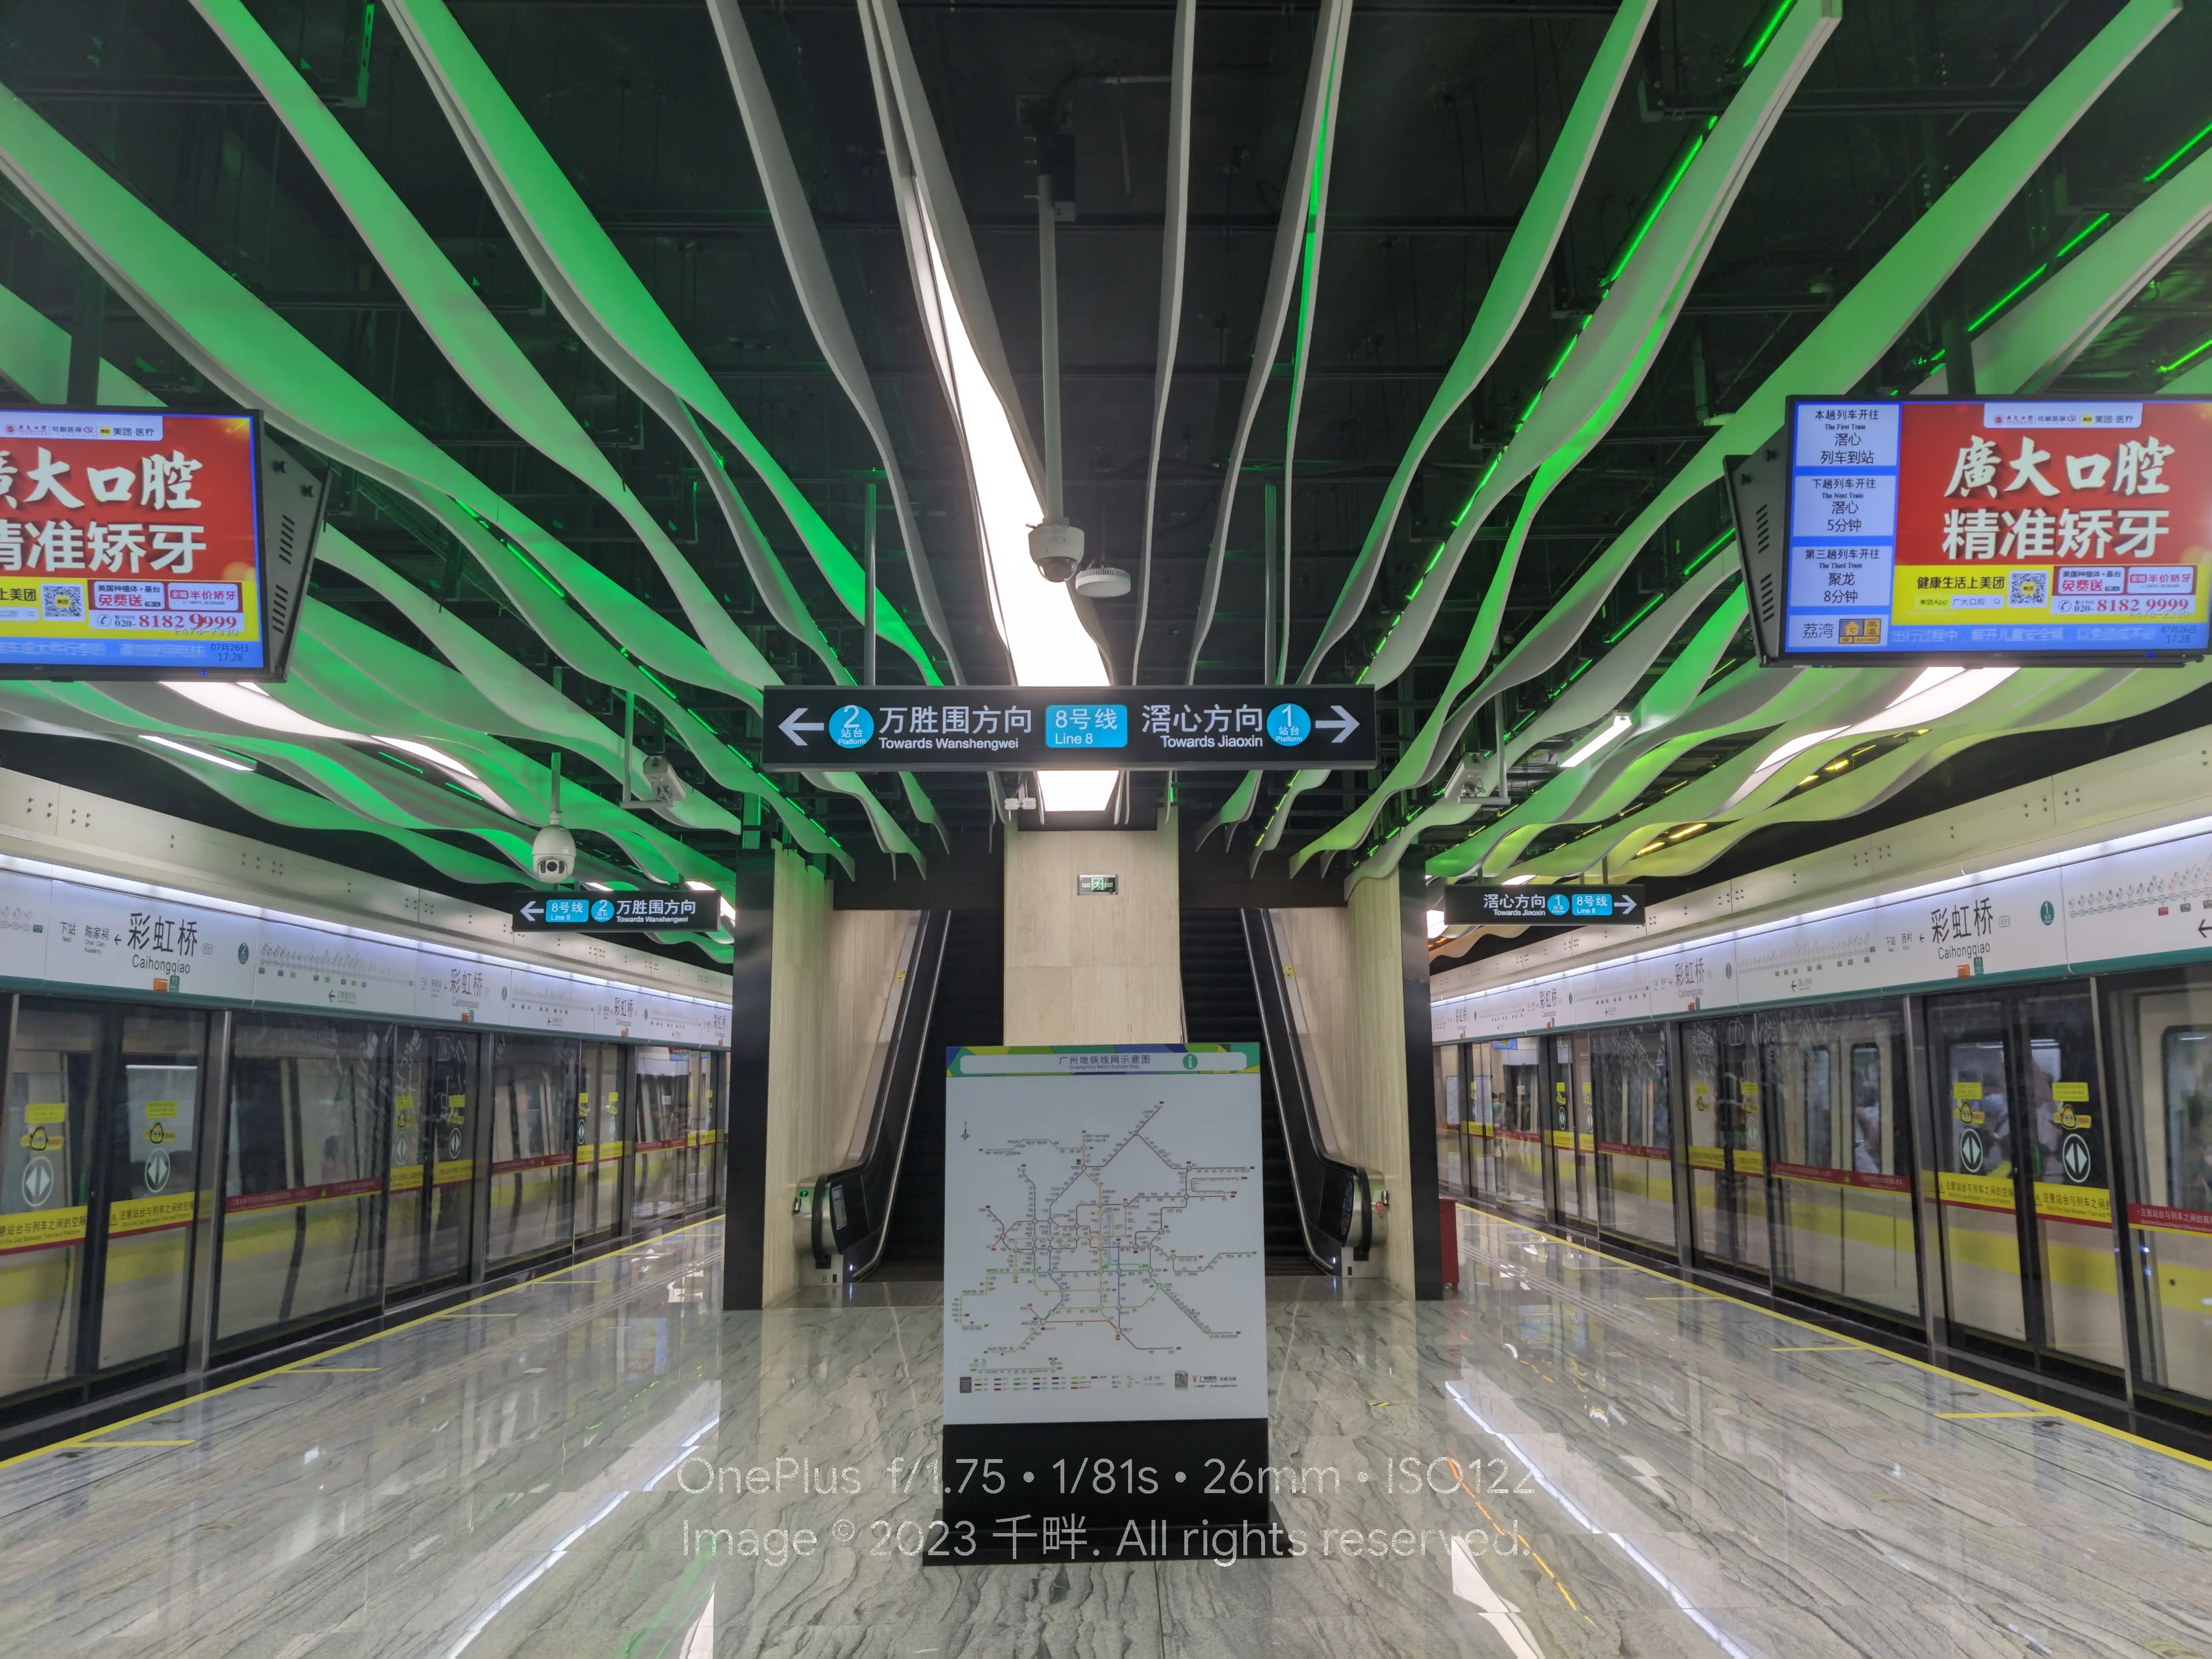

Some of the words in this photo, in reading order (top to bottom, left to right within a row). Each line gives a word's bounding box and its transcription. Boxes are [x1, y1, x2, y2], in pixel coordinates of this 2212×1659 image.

[1815, 409, 1879, 420] 本趟列车开往
[1835, 432, 1861, 447] 滘心
[1821, 450, 1875, 465] 列车到站
[1812, 478, 1876, 489] 下趟列车开往
[1832, 501, 1859, 515] 滘心
[1827, 518, 1861, 532] 5分钟
[1942, 508, 2170, 562] 精准矫牙
[1805, 549, 1880, 560] 第三趟列车开往
[1828, 572, 1855, 586] 聚龙
[1917, 576, 2005, 590] 健康生活上美团
[2062, 579, 2103, 592] 免费送
[99, 594, 143, 607] 免费送
[190, 590, 237, 600] 半价矫牙
[1824, 590, 1858, 604] 8分钟
[2097, 599, 2140, 612] 8182
[2146, 599, 2189, 611] 9999
[139, 615, 185, 629] 8182
[189, 613, 237, 629] 9999
[1803, 623, 1835, 639] 荔湾
[2161, 626, 2197, 634] 07月26日
[2166, 635, 2190, 643] 17:28
[211, 644, 248, 652] 07月26日
[218, 653, 243, 661] 17:28
[843, 704, 860, 729] 2
[878, 705, 1032, 734] 万胜围方向
[1055, 707, 1118, 730] 8号线
[1141, 704, 1263, 734] 滘心方向
[1282, 704, 1292, 727] 1
[841, 728, 863, 738] 站台
[1278, 726, 1300, 736] 站台
[838, 738, 867, 746] Platform
[878, 737, 933, 749] Towards
[936, 737, 1019, 751] Wanshengwei
[1055, 733, 1082, 744] Line
[1085, 733, 1093, 744] 8
[1160, 735, 1215, 748] Towards
[1218, 735, 1263, 748] Jiaoxin
[1276, 735, 1303, 743] Platform
[551, 901, 584, 913] 8号线
[599, 899, 607, 912] 2
[616, 899, 696, 915] 万胜围方向
[1483, 893, 1546, 909] 滘心方向
[1555, 895, 1560, 906] 1
[1576, 895, 1608, 907] 8号线
[2044, 902, 2049, 915] 1
[645, 916, 688, 924] Wanshengwei
[1931, 897, 1993, 943] 彩虹桥
[60, 921, 77, 936] 下站
[85, 925, 109, 941] 陈家祠
[127, 912, 197, 957] 彩虹桥
[1885, 935, 1896, 946] 下站
[1901, 931, 1912, 944] 西村
[241, 943, 246, 955] 2
[1938, 941, 1991, 960] Caihongqiao
[132, 954, 190, 976] Caihongqiao
[1675, 958, 1705, 987] 彩虹桥
[172, 977, 178, 985] 11
[450, 968, 483, 997] 彩虹桥
[1540, 987, 1557, 1009] 彩虹桥
[1679, 988, 1704, 998] Caihongqiao
[452, 997, 479, 1010] Caihongqiao
[614, 997, 633, 1018] 彩虹桥
[1059, 1055, 1150, 1064] 广州地铁线网示意图
